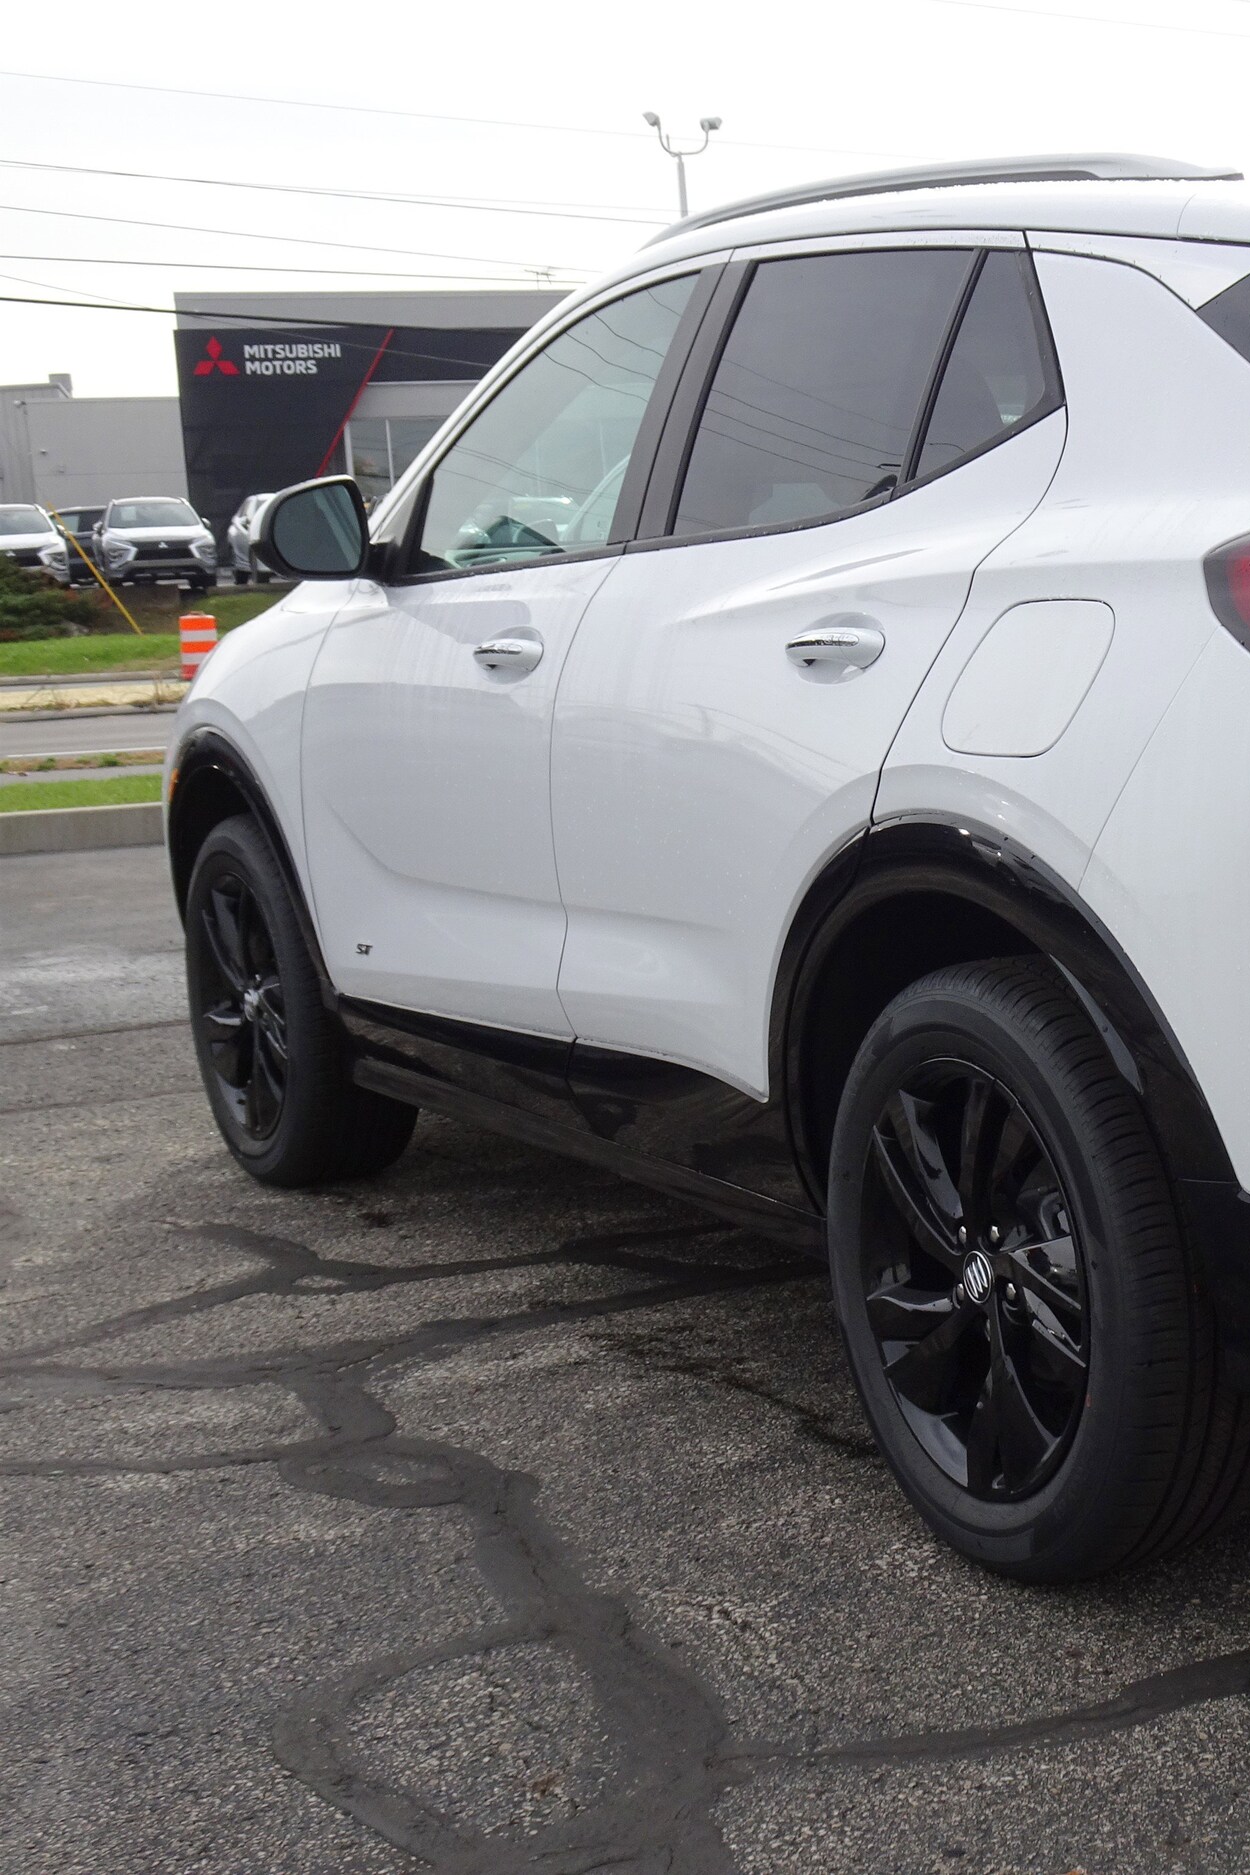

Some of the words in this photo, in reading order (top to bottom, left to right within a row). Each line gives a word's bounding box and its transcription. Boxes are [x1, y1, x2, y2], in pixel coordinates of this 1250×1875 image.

[243, 343, 342, 359] MITSUBISHI
[245, 360, 318, 375] MOTORS
[355, 943, 373, 956] ST
